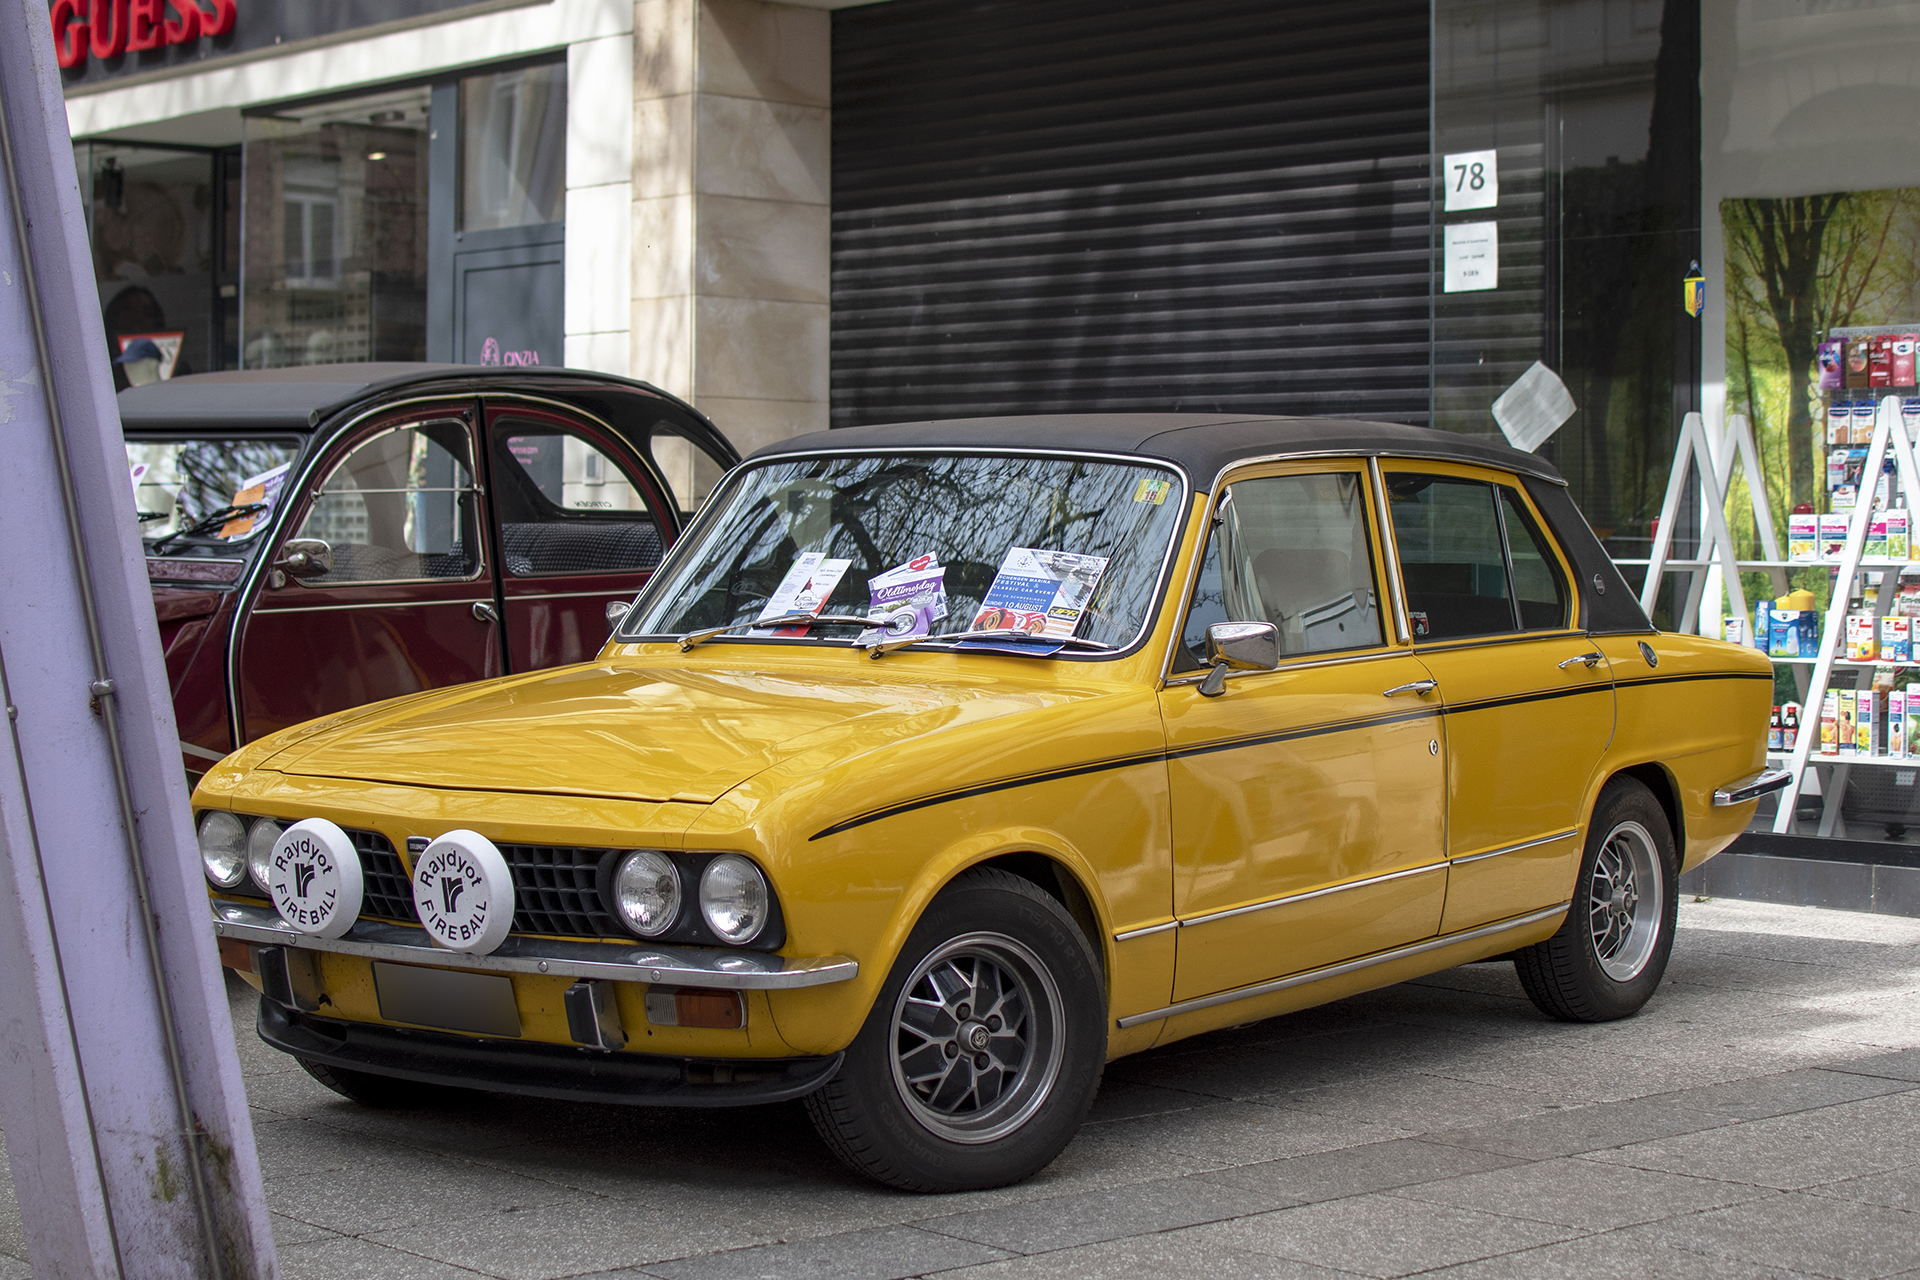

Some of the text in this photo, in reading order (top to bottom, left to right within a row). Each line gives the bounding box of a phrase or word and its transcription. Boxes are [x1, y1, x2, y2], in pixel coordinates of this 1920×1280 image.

[1453, 162, 1485, 192] 78
[504, 351, 539, 366] CINZIA
[1145, 491, 1158, 501] 15
[996, 579, 1030, 587] FESTIVAL
[1014, 603, 1044, 612] AUGUST
[1055, 608, 1079, 617] JPR
[275, 838, 333, 874] Raydyot
[420, 850, 482, 887] Raydyot
[276, 883, 336, 925] FIREBALL
[422, 900, 487, 940] FIREBALL
